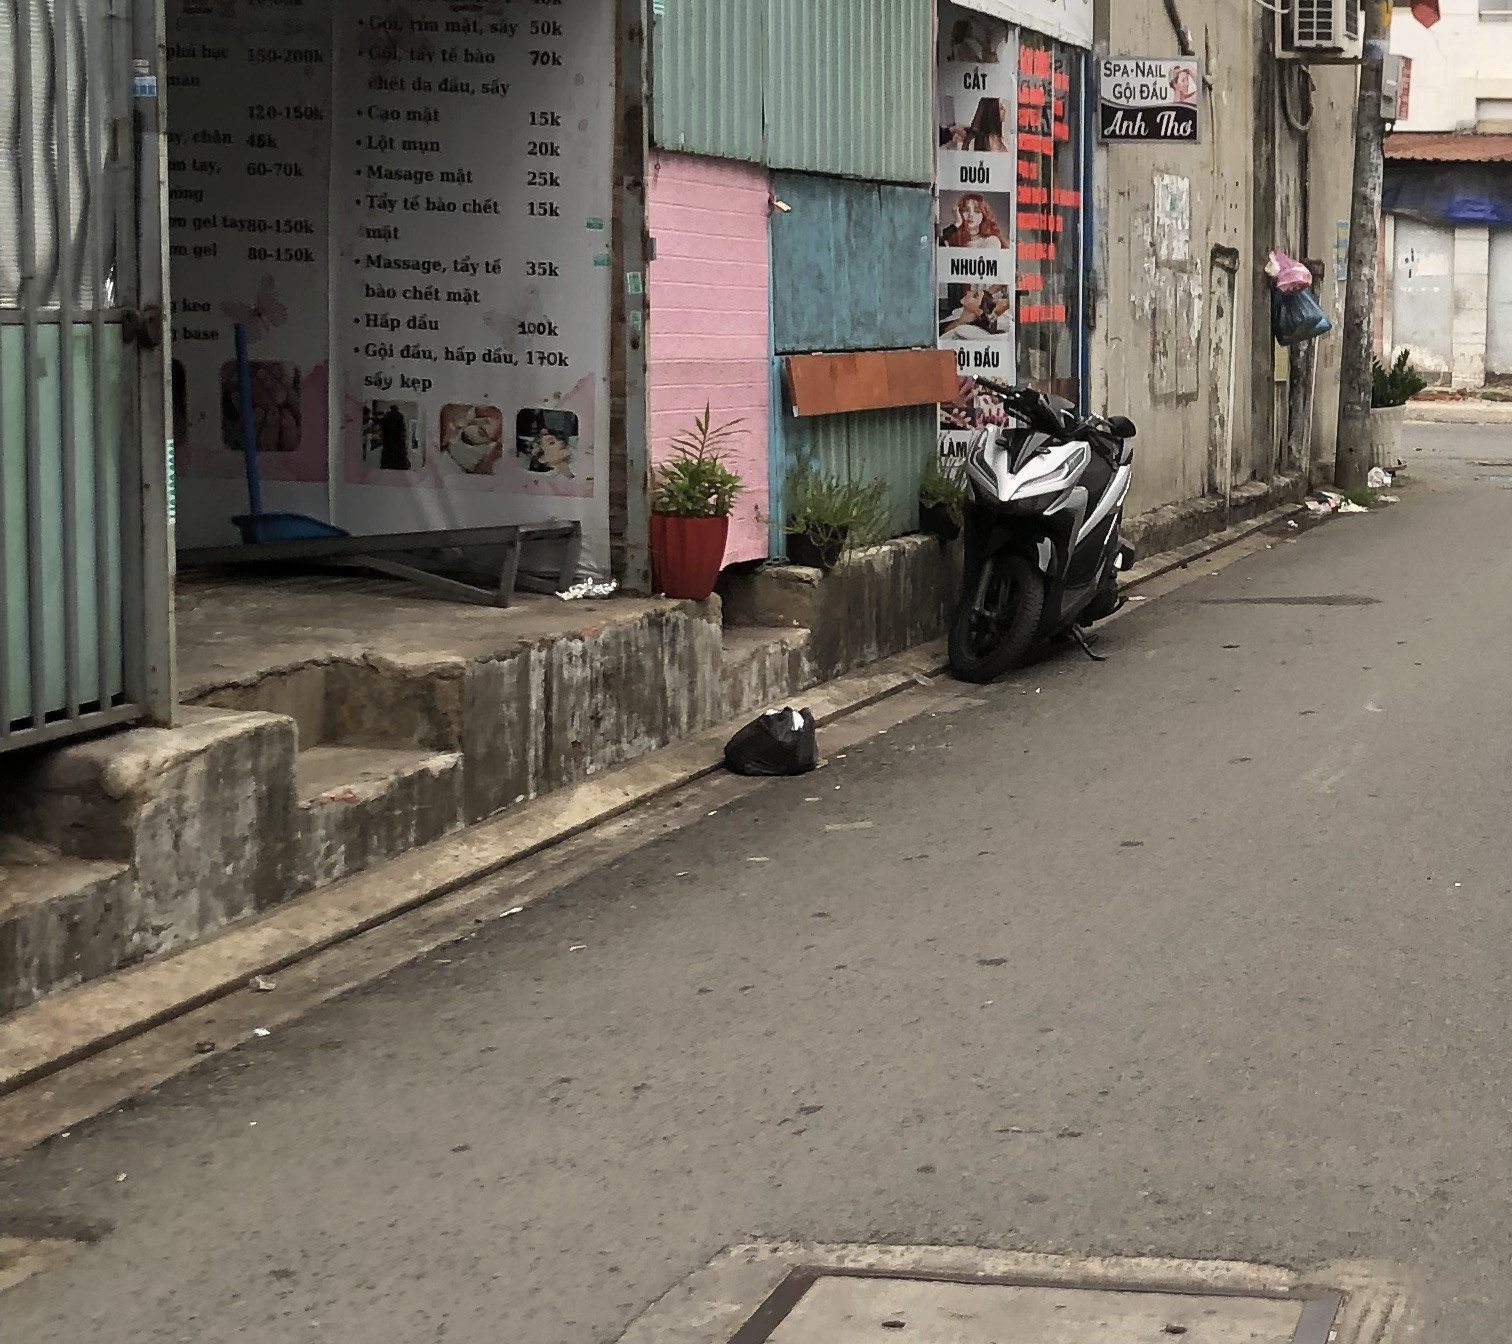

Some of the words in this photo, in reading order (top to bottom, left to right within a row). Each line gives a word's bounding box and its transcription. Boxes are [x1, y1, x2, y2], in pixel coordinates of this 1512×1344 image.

[530, 20, 562, 36] 50k
[529, 50, 562, 66] 70k
[963, 66, 988, 90] CẮT
[1112, 81, 1136, 104] GỘI
[528, 110, 562, 127] 15k
[1104, 110, 1149, 136] Anh
[527, 140, 561, 157] 20k
[367, 164, 435, 185] Masage
[527, 170, 561, 187] 25k
[527, 200, 561, 217] 15k
[365, 254, 447, 275] Massage,
[526, 260, 560, 277] 35k
[950, 256, 998, 280] NHUỘM
[364, 282, 397, 299] bào
[402, 285, 441, 302] chết
[446, 287, 481, 306] mặt
[364, 342, 395, 360] Gội
[955, 347, 971, 370] ỘI
